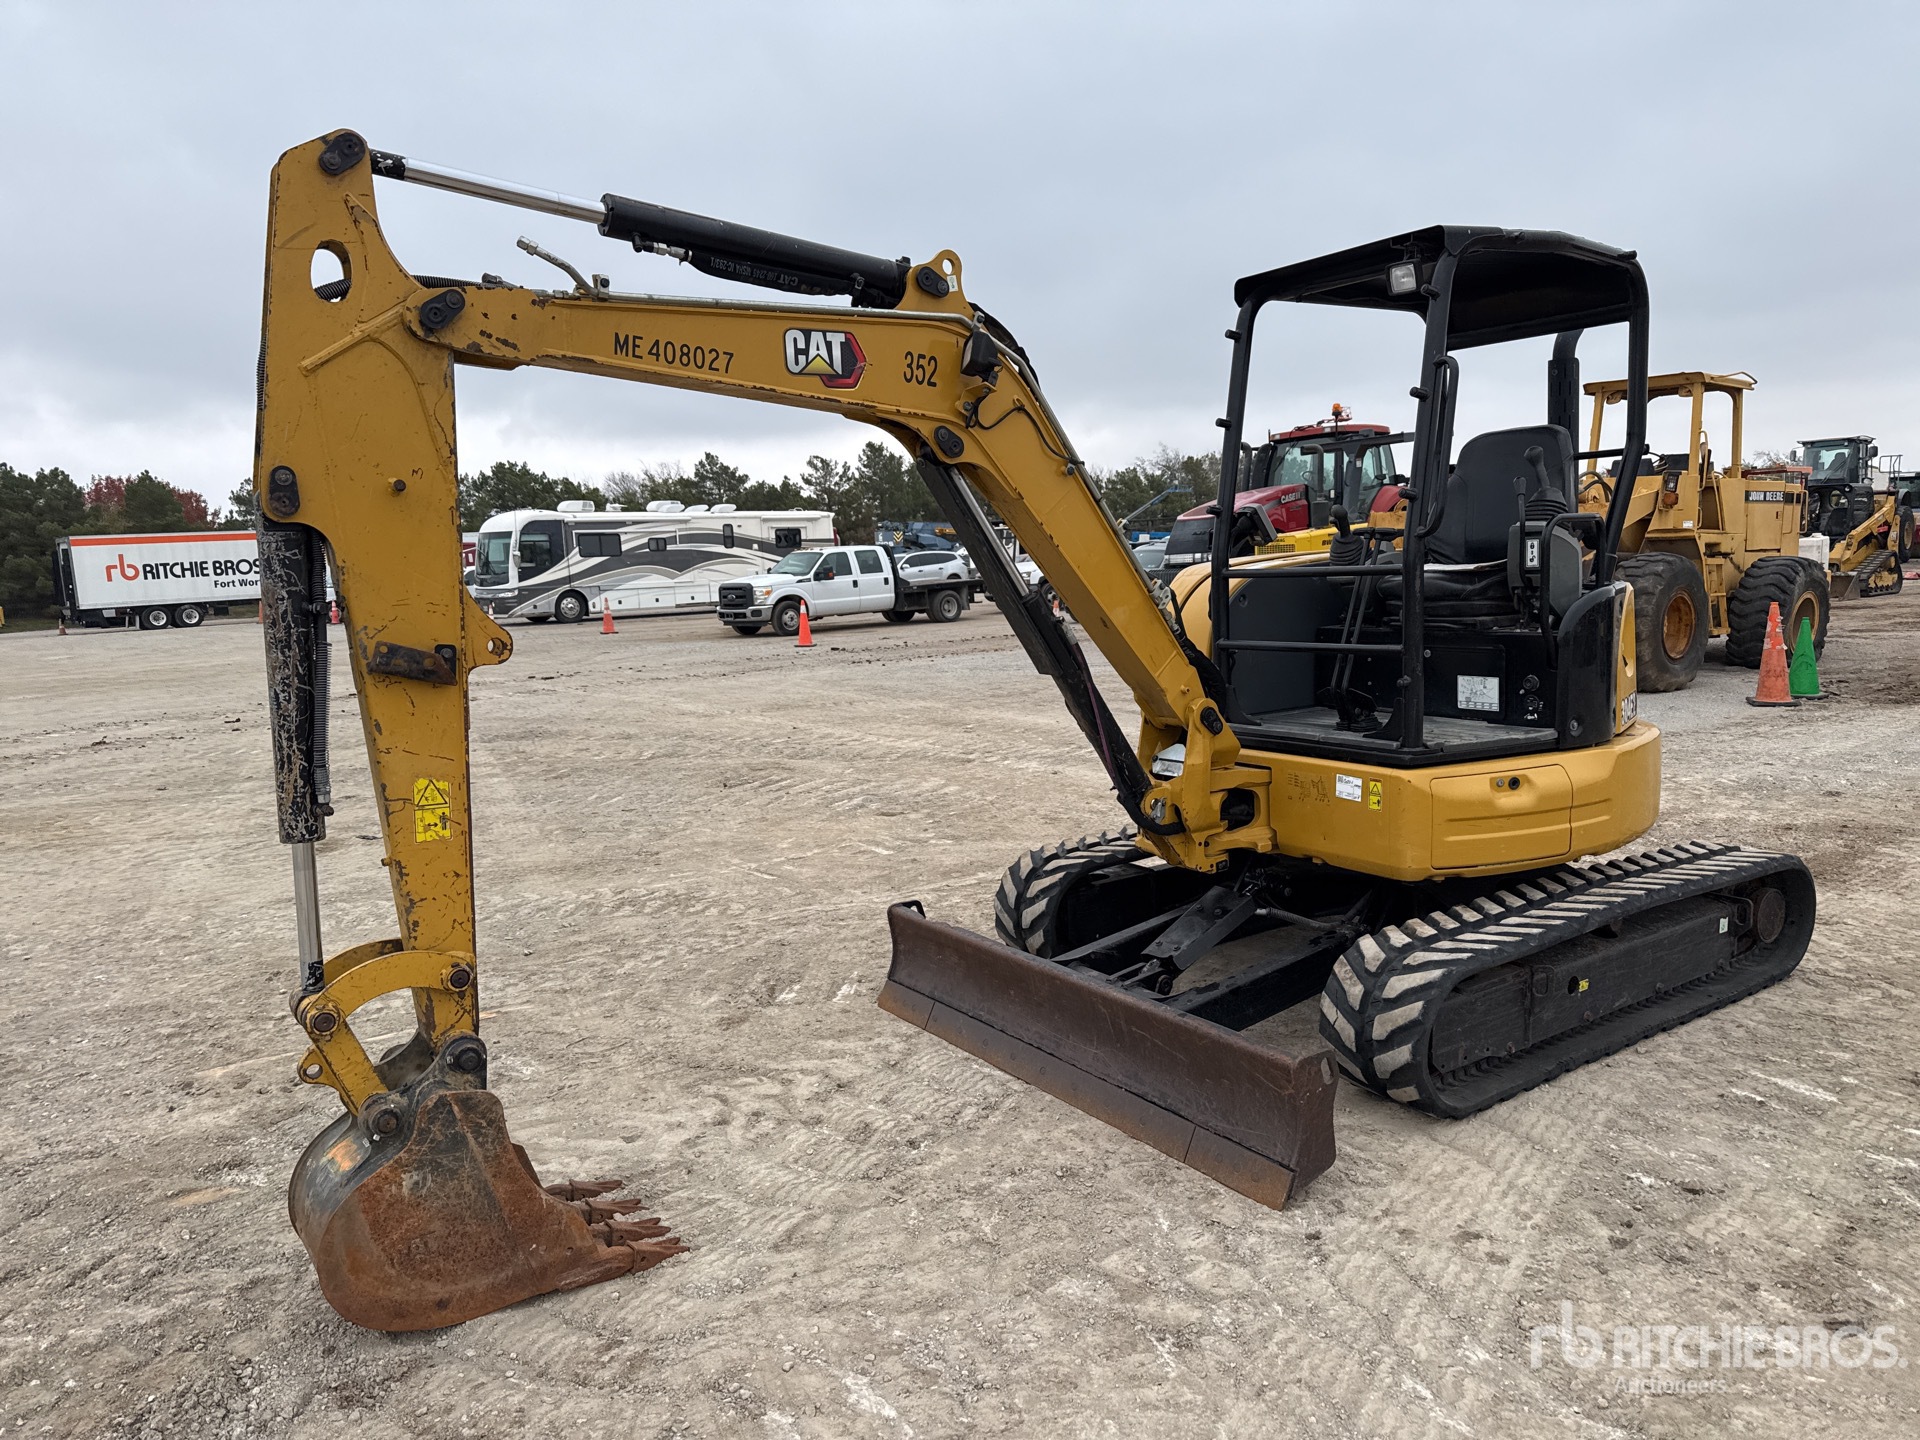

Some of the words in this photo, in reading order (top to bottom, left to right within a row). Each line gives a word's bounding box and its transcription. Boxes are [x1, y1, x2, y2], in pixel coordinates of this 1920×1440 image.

[614, 331, 734, 374] ME408027
[784, 329, 846, 375] CAT
[903, 350, 938, 388] 352
[1749, 491, 1765, 501] JOHN
[1765, 491, 1784, 501] DEERE
[142, 560, 210, 581] RITCHIE
[214, 579, 236, 589] Fort
